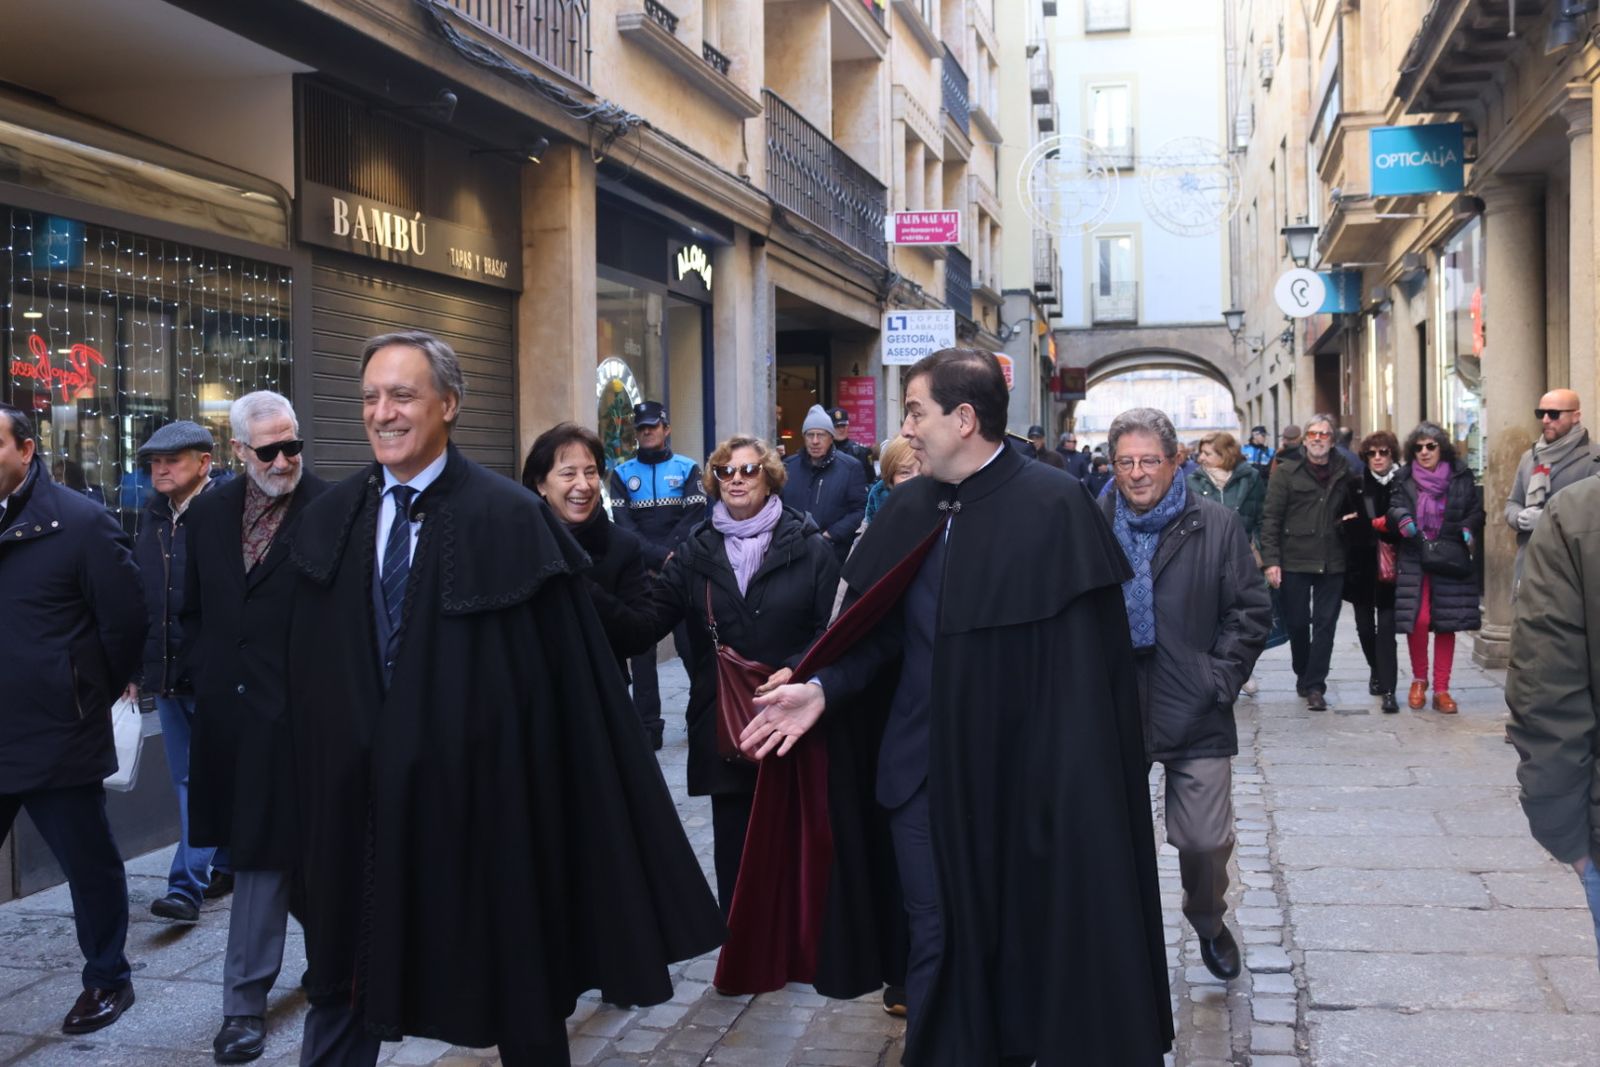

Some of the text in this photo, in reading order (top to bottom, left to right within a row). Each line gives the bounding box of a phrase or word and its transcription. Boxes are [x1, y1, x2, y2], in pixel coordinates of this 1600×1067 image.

[332, 196, 426, 256] BAMBÚ
[449, 247, 508, 279] TAPAS Y BRASAS
